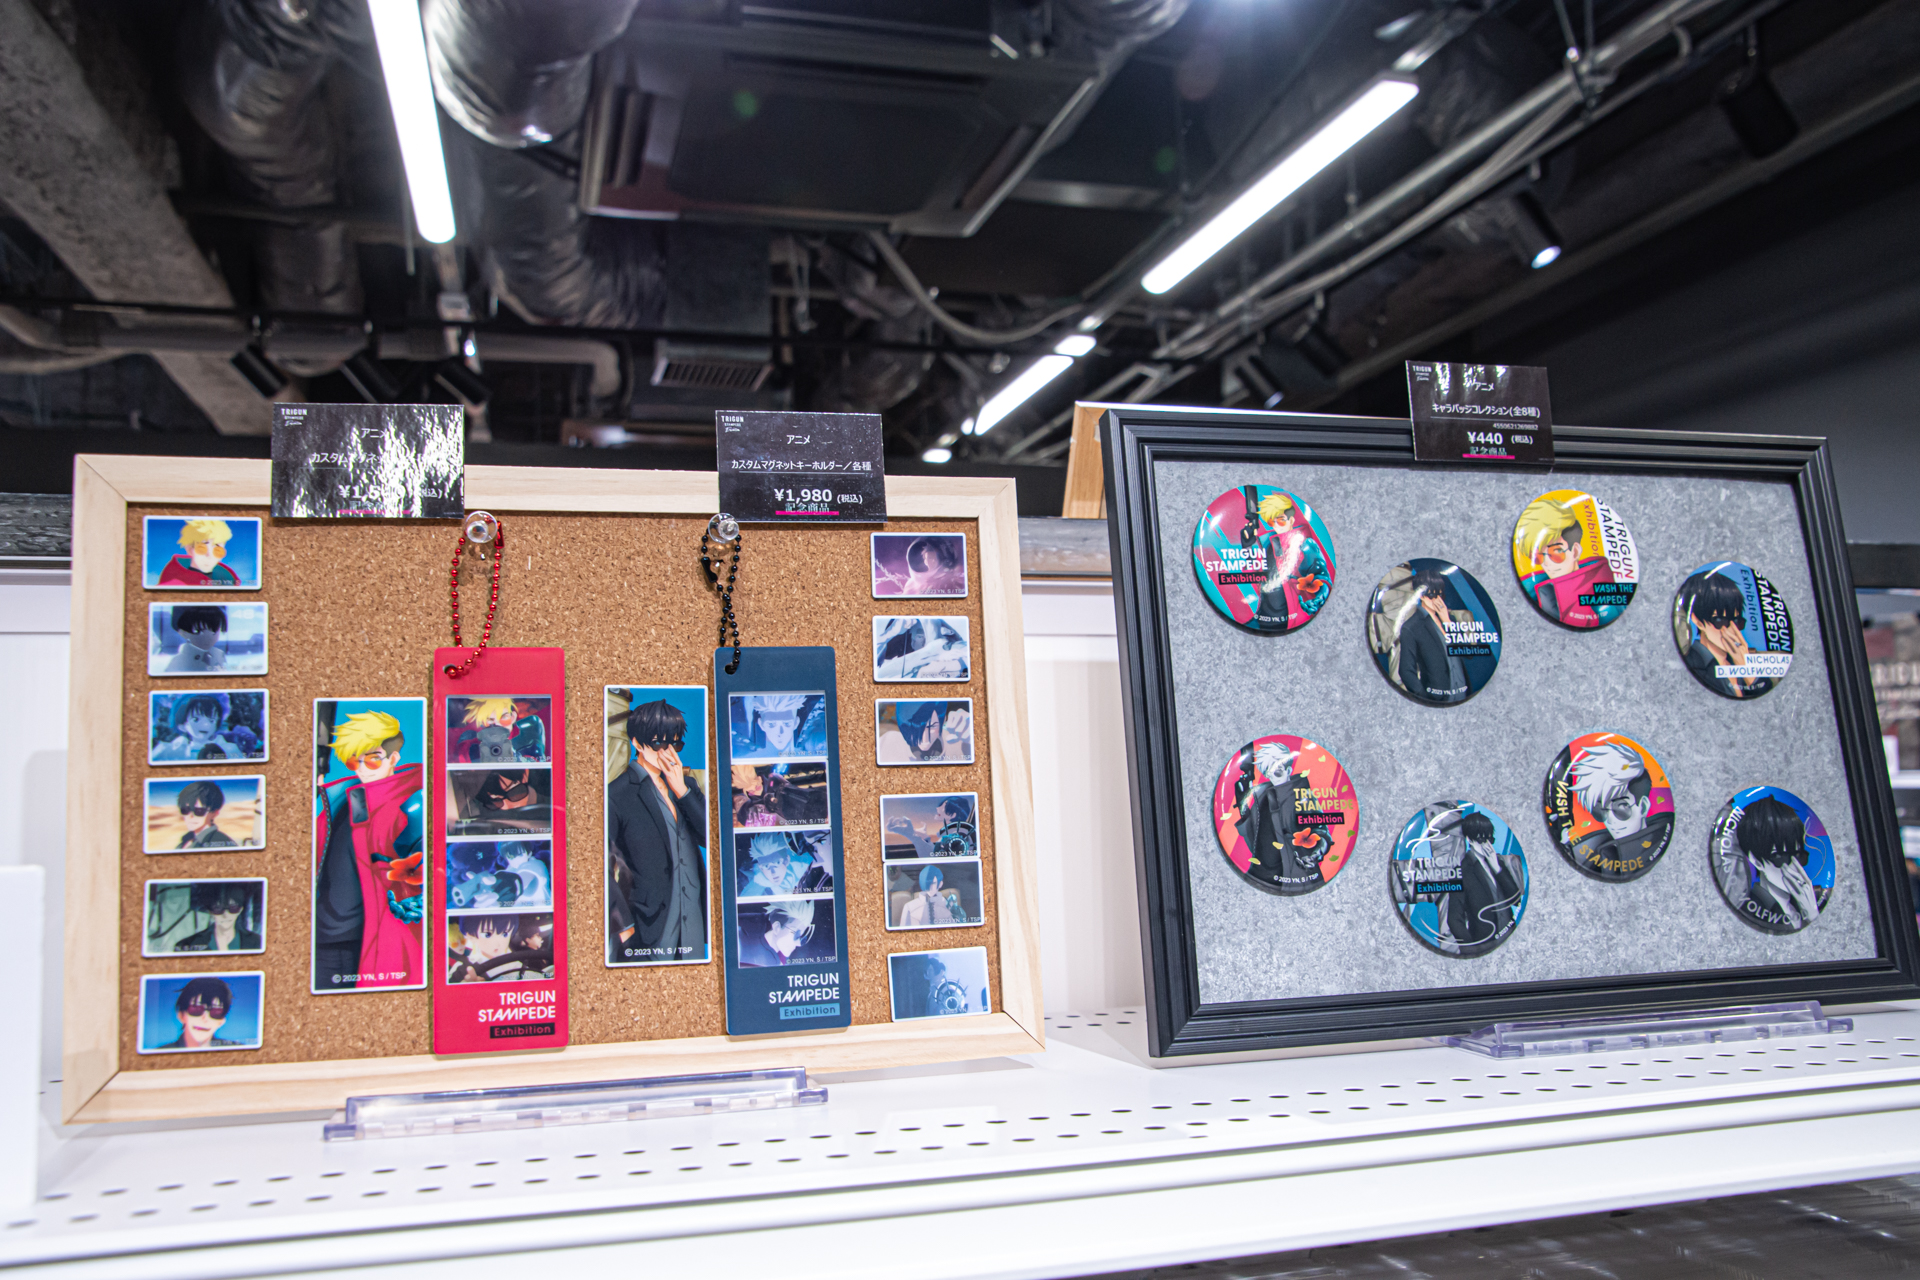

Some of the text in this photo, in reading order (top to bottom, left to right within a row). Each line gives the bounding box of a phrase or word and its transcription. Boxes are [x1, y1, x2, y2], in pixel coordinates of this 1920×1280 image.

[1474, 382, 1494, 392] アニメ
[281, 408, 308, 416] TRIGUN
[786, 434, 811, 445] アニメ
[1467, 432, 1504, 444] ¥440
[774, 488, 863, 504] ¥1,980 (税込)
[1221, 548, 1267, 559] TRIGUN
[1614, 520, 1635, 579] TRIGUN
[1206, 560, 1268, 572] STAMPEDE
[1221, 574, 1267, 583] Exhibition
[1594, 584, 1633, 593] VASH THE
[1580, 595, 1627, 605] STAMPEDE
[1740, 568, 1759, 632] Exhibition
[1754, 570, 1780, 651] STAMPEDE
[1443, 621, 1484, 632] TRIGUN
[1771, 593, 1791, 651] TRIGUN
[1445, 632, 1499, 643] STAMPEDE
[1449, 647, 1490, 655] Exhibition
[1746, 656, 1790, 664] NICHOLAS
[1718, 667, 1785, 676] D. WOLFWOOD
[1294, 788, 1338, 799] TRIGUN
[1295, 799, 1353, 812] STAMPEDE
[1298, 815, 1343, 824] Exhibition
[1556, 780, 1644, 872] VASH THE STAMPEDE
[1721, 806, 1746, 873] NICHOLAS
[1417, 857, 1461, 868] TRIGUN
[1402, 868, 1463, 882] STAMPEDE
[1417, 883, 1462, 893] Exhibition
[342, 974, 361, 982] 2023
[787, 972, 839, 987] TRIGUN
[499, 990, 556, 1006] TRIGUN
[769, 987, 840, 1004] STAMPEDE
[478, 1006, 556, 1022] STAMPEDE
[784, 1006, 836, 1017] Exhibition
[494, 1026, 550, 1037] Exhibition
